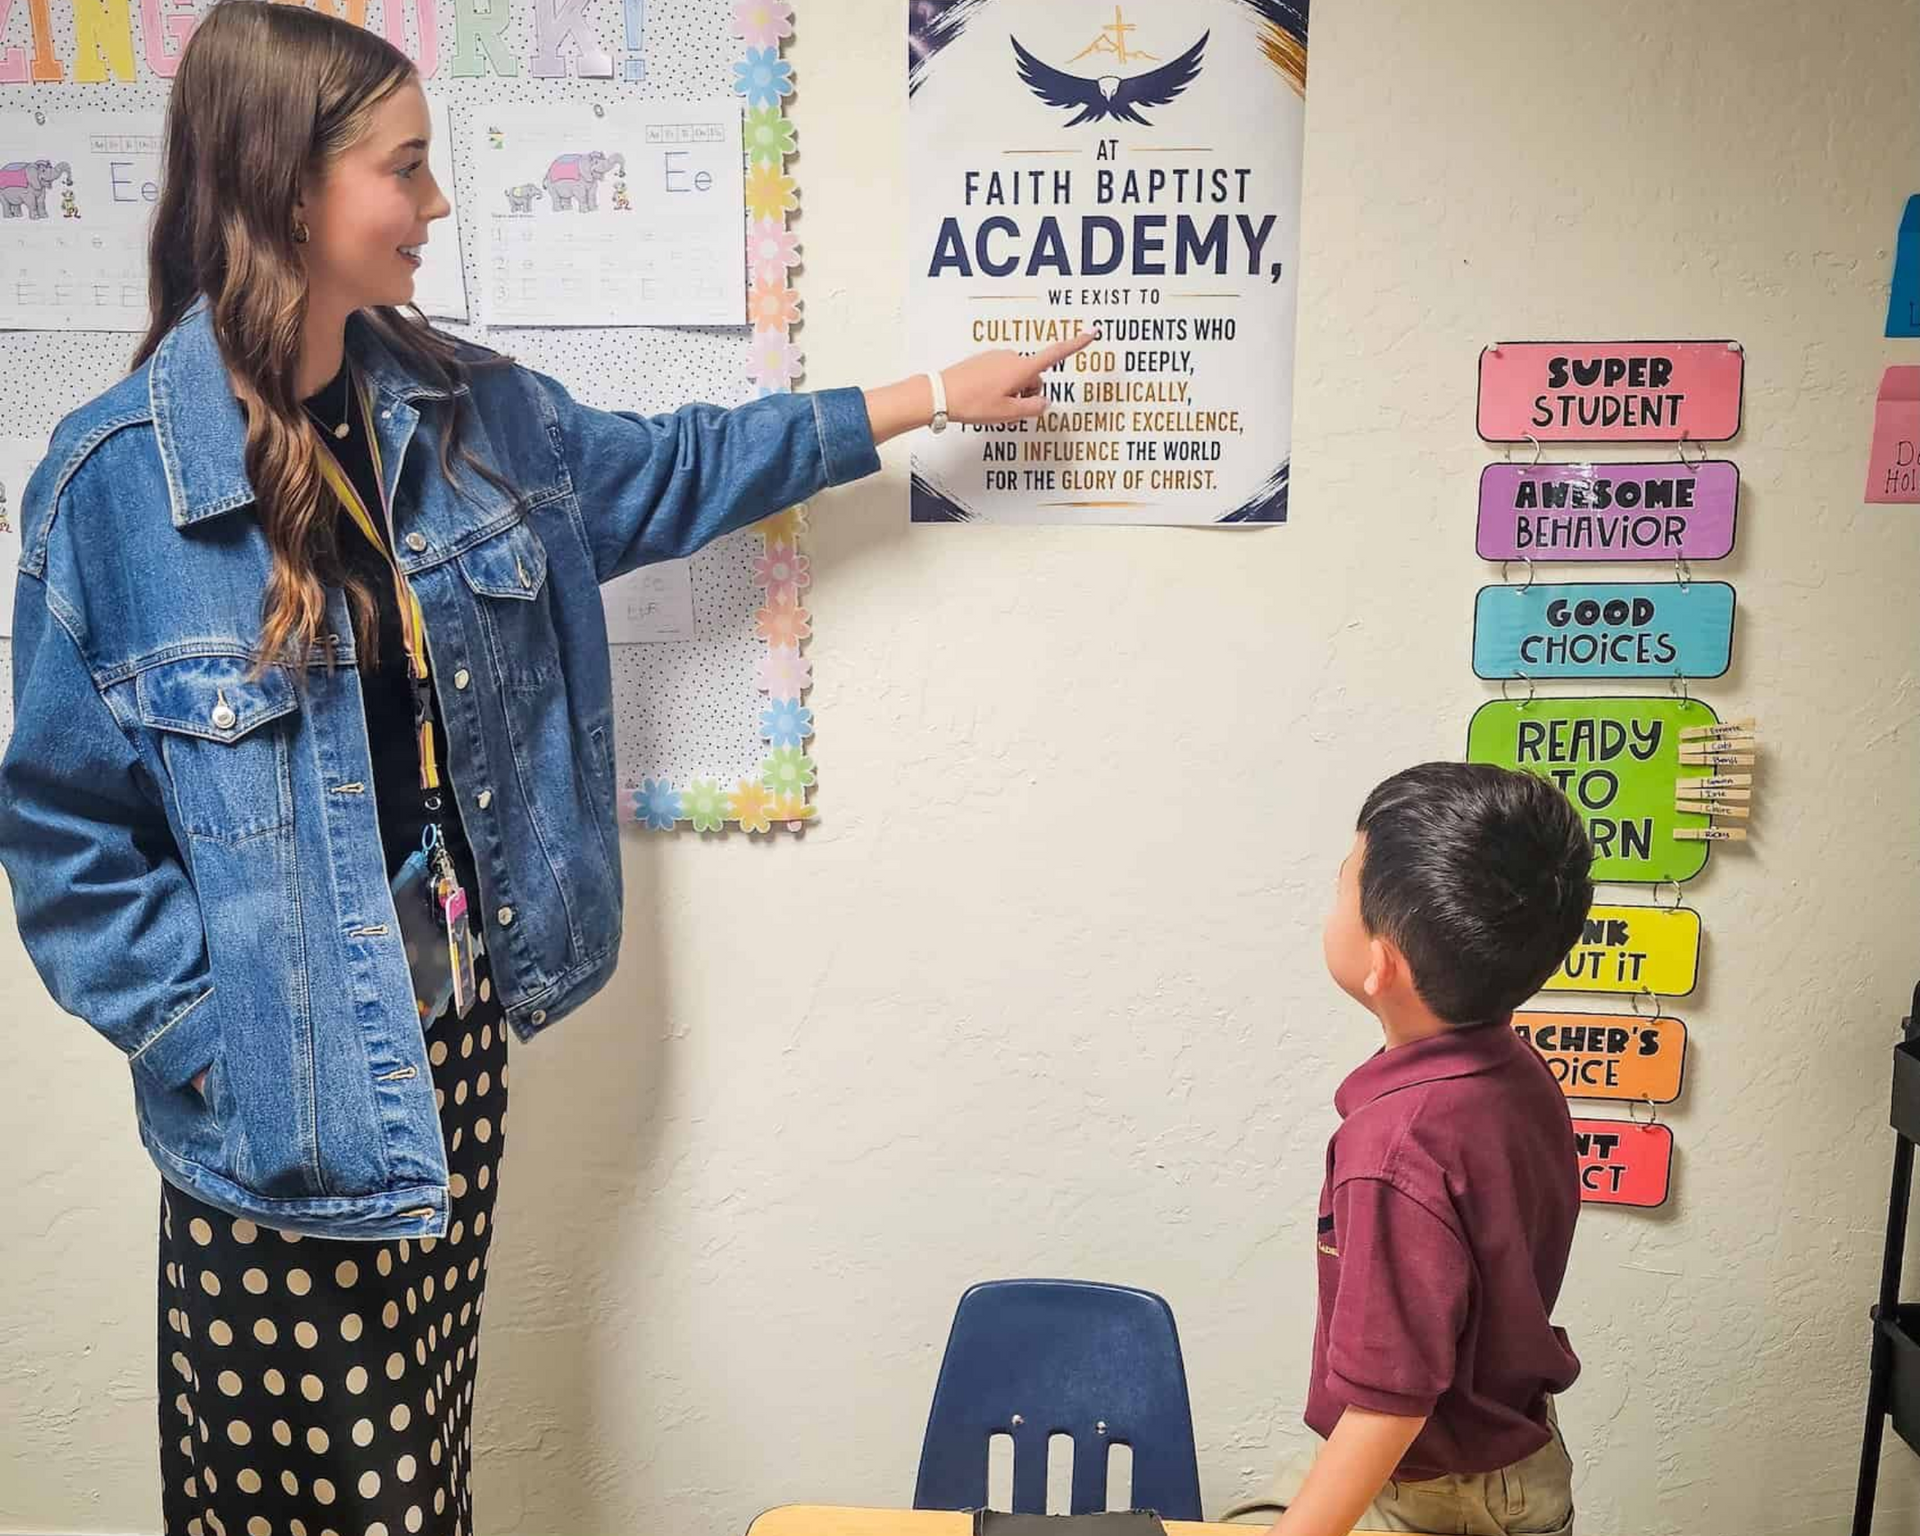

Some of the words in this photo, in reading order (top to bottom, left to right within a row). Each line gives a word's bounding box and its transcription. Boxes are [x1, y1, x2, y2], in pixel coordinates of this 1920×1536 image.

[312, 0, 645, 81] ORK!
[1096, 140, 1119, 161] AT
[665, 151, 713, 192] Ee
[965, 170, 1071, 205] FAITH
[1097, 168, 1251, 204] BAPTIST
[928, 214, 1283, 283] ACADEMY,
[1048, 290, 1073, 305] WE
[1082, 289, 1131, 305] EXIST
[1140, 288, 1160, 304] TO
[1092, 319, 1187, 341] STUDENTS
[1195, 318, 1236, 341] WHO
[1075, 351, 1116, 372] GOD
[1125, 351, 1195, 376] DEEPLY,
[1548, 357, 1673, 389] SUPER
[1043, 382, 1075, 403] INK
[1084, 382, 1191, 405] BIBLICALLY,
[1036, 412, 1125, 432] ACADEMIC
[1133, 411, 1243, 435] EXCELLENCE,
[1532, 395, 1684, 427] STUDENT
[983, 442, 1017, 462] AND
[1024, 441, 1119, 462] INFLUENCE
[1126, 441, 1156, 461] THE
[1164, 441, 1220, 461] WORLD
[1896, 440, 1920, 466] D
[986, 470, 1017, 490] FOR
[1024, 470, 1055, 490] THE
[1062, 470, 1115, 490] GLORY
[1123, 470, 1144, 490] OF
[1151, 470, 1217, 490] CHRIST.
[1515, 479, 1696, 509] AWESOME
[1547, 598, 1655, 628] GOOD
[1518, 719, 1663, 762] READY
[1551, 770, 1618, 809] TO
[1514, 1025, 1659, 1055] ACHER'S
